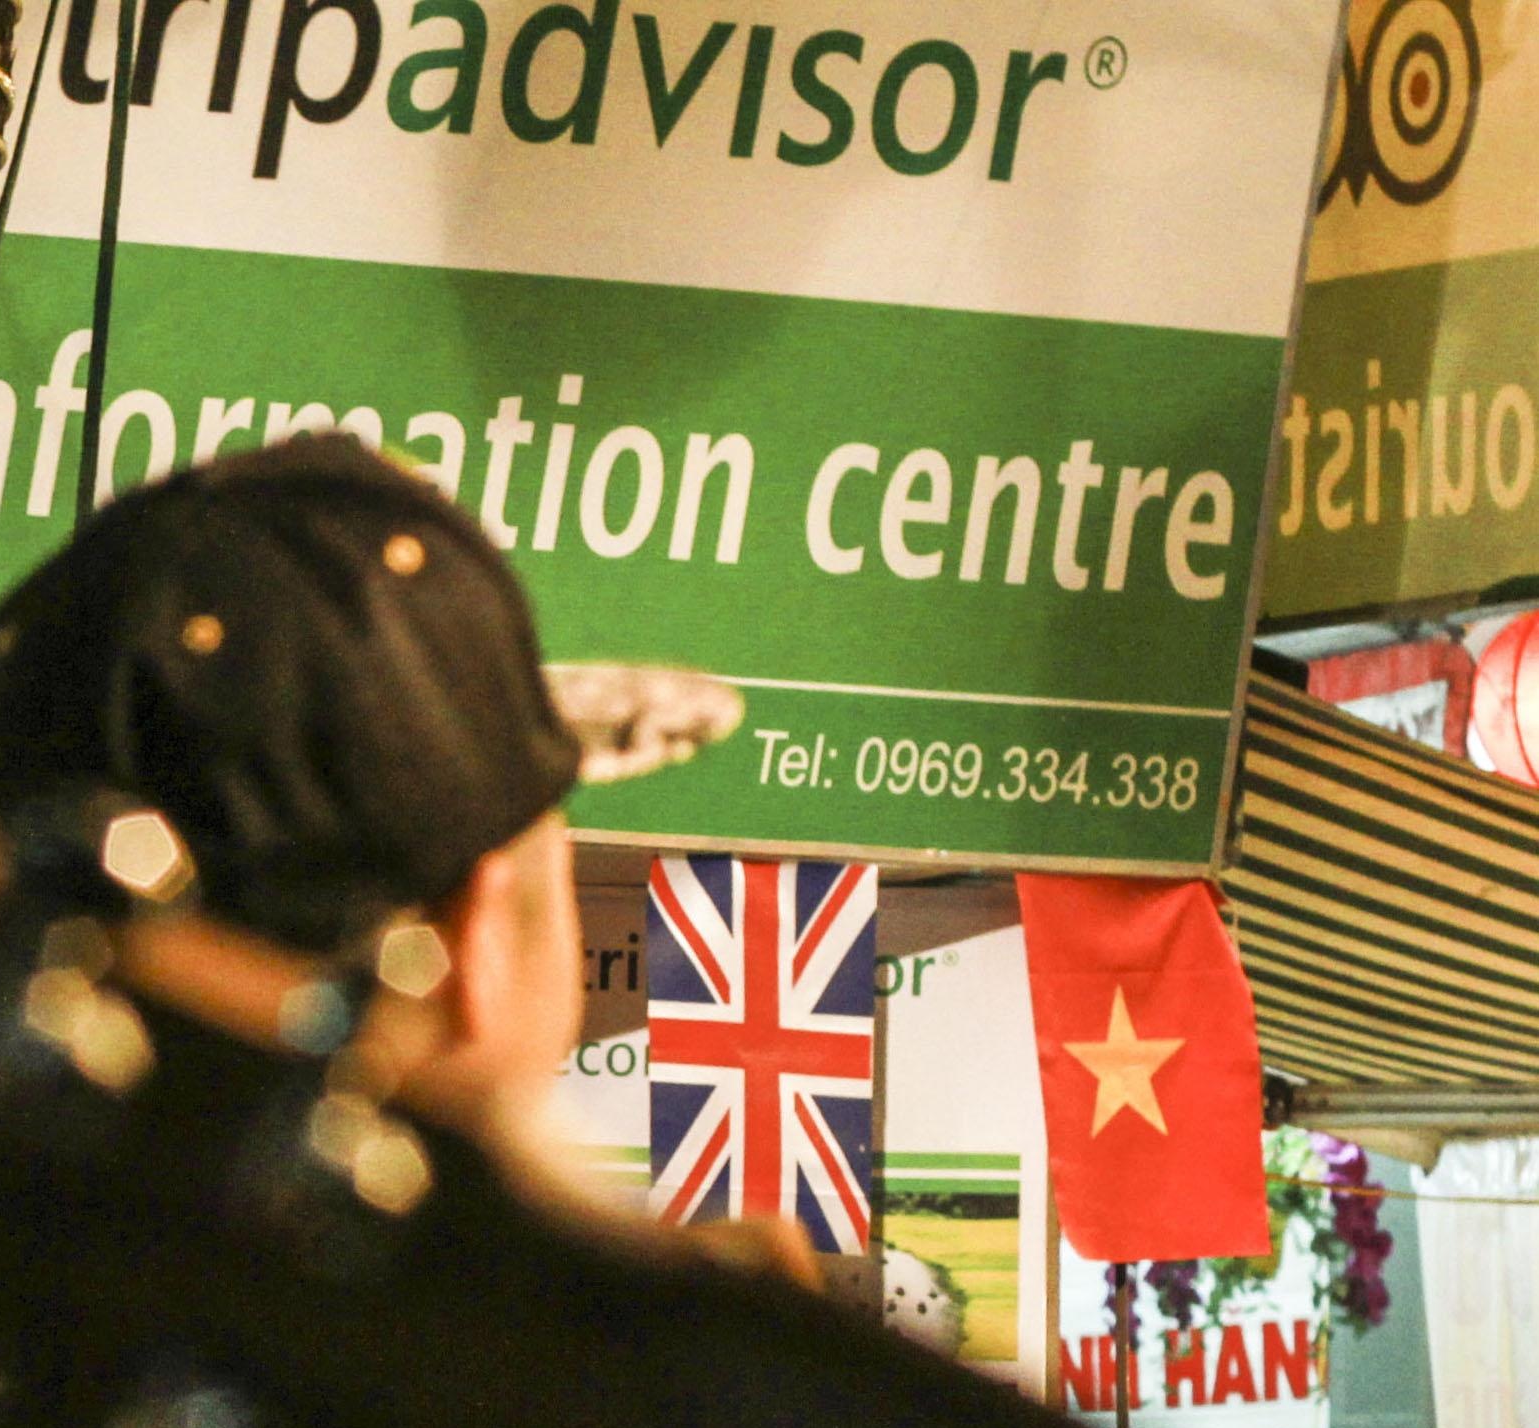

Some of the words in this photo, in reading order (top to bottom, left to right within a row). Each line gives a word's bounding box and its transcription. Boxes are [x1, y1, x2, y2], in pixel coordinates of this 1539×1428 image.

[805, 438, 1235, 601] centre
[754, 729, 838, 791] Tel:
[854, 736, 1200, 814] 0969.334.338
